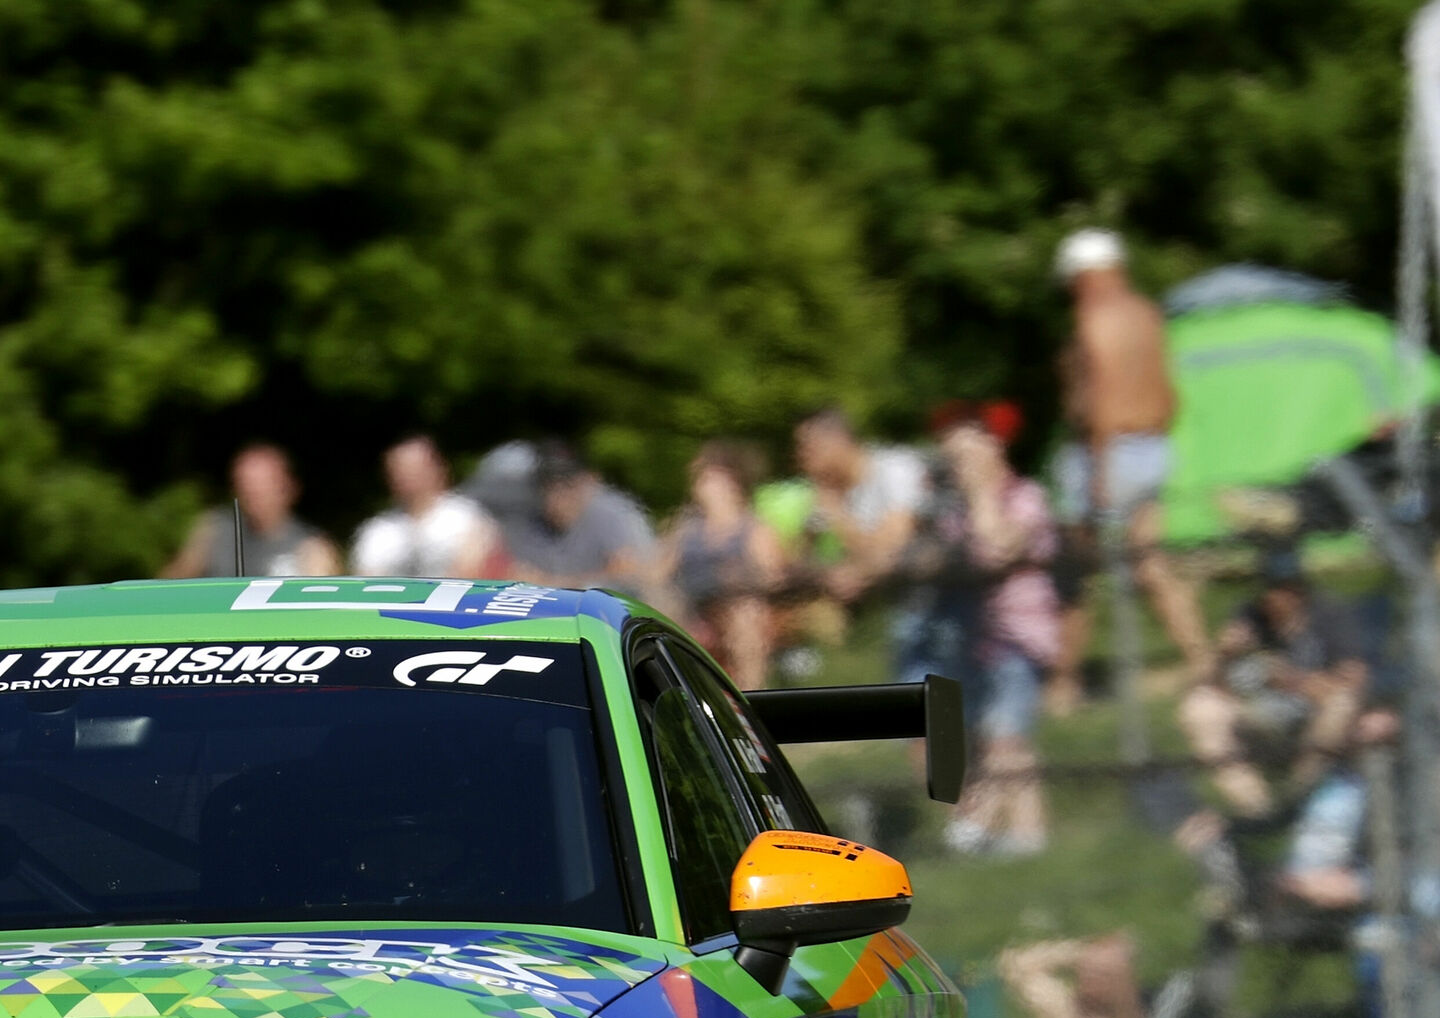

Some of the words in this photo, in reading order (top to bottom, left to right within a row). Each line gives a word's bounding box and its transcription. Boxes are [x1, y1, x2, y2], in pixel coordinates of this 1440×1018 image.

[130, 673, 320, 686] SIMULATOR
[81, 958, 144, 967] by
[160, 957, 310, 967] smart
[327, 961, 560, 998] concepts
